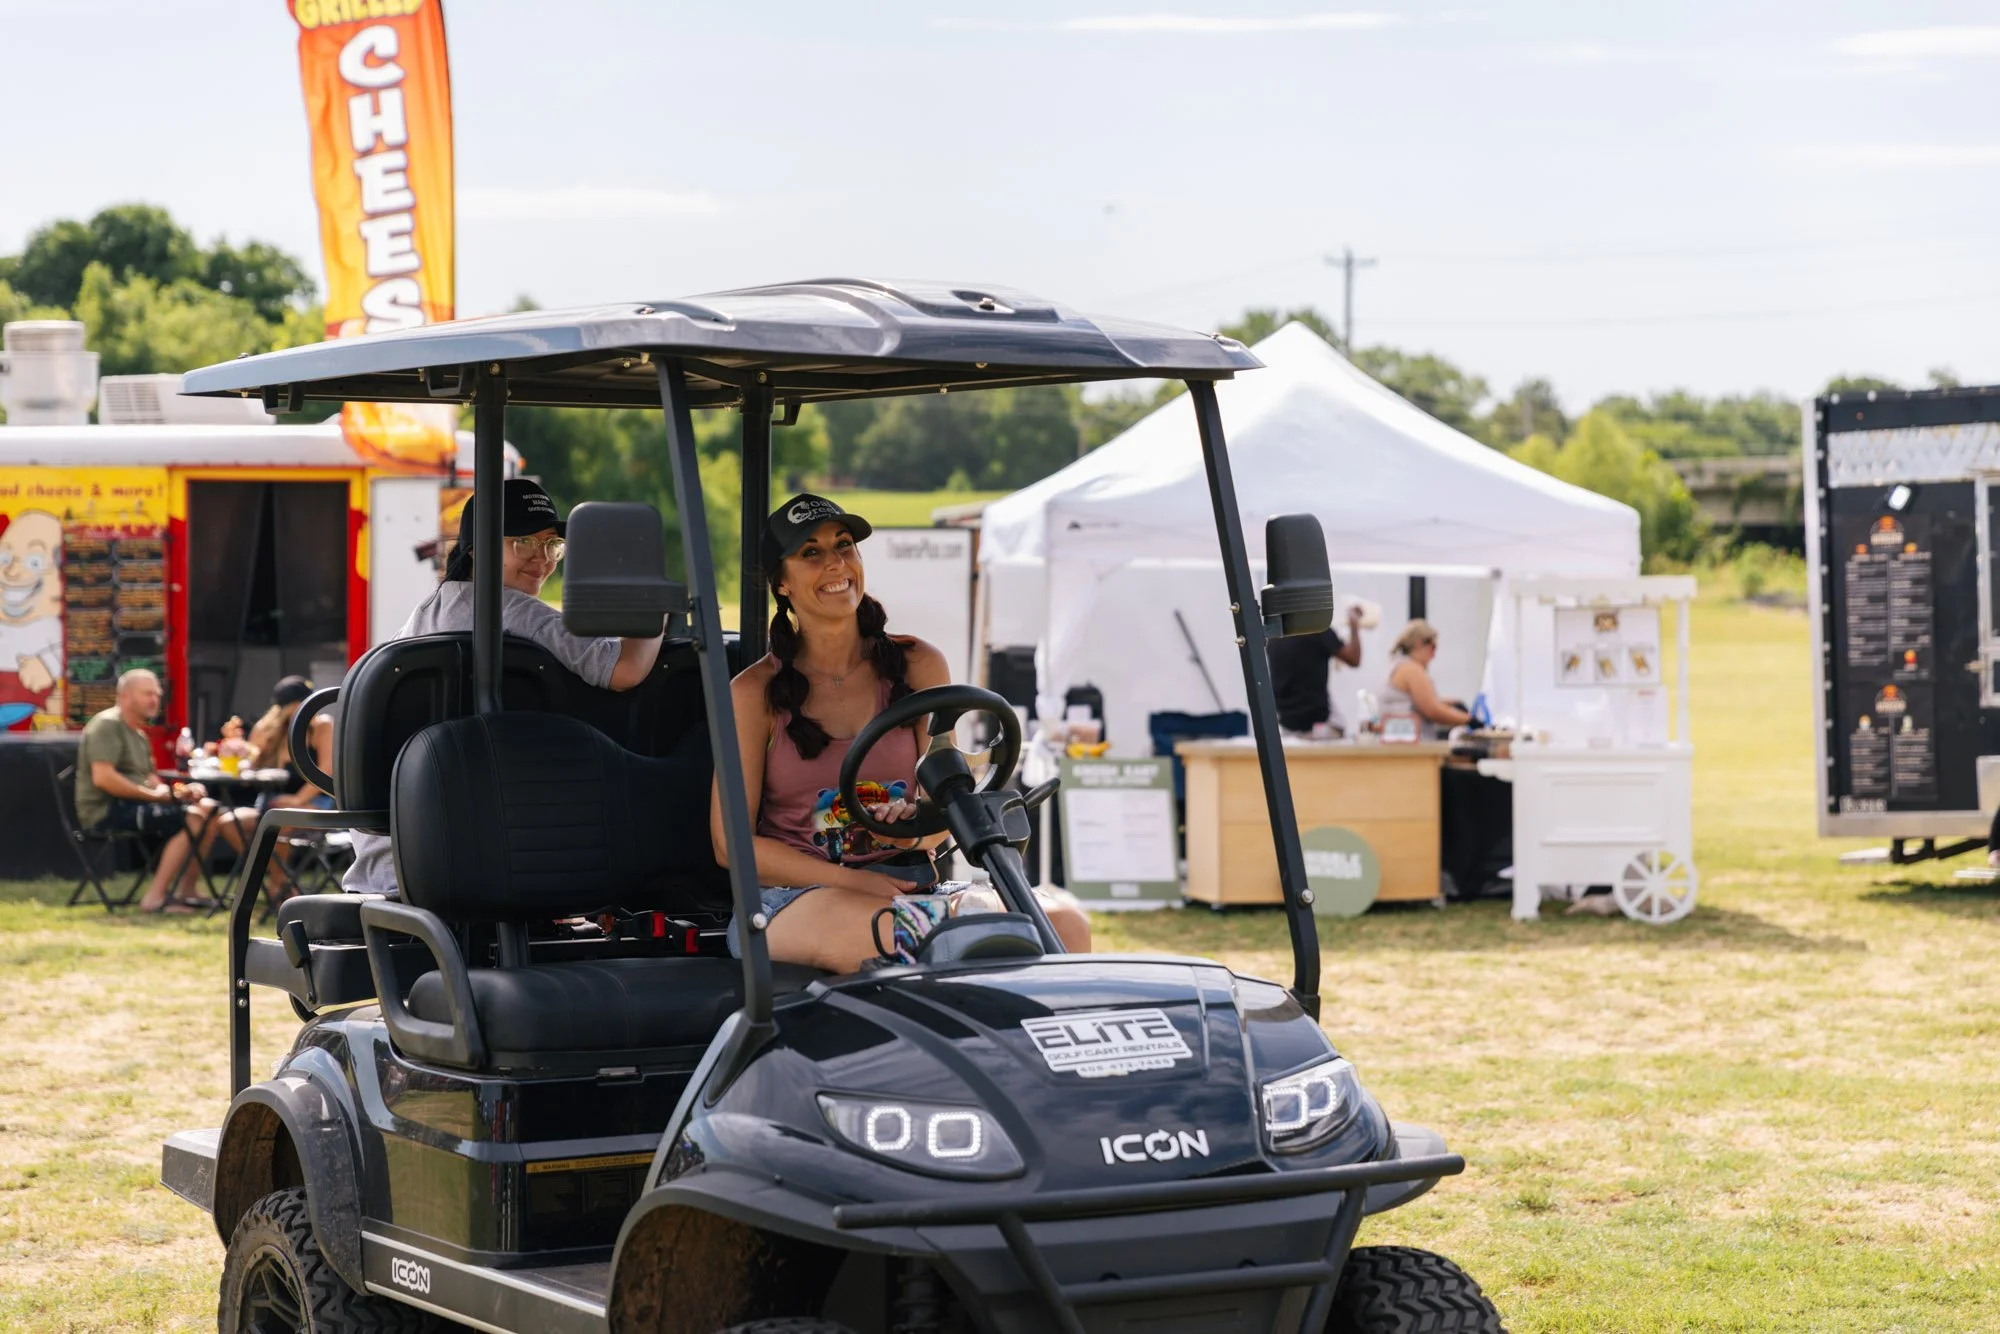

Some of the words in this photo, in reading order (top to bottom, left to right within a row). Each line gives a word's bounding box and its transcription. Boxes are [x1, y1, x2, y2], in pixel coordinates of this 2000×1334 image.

[1030, 1017, 1176, 1049] ELITE
[1049, 1051, 1081, 1061] GOLF
[1083, 1046, 1119, 1057] CART
[1121, 1042, 1182, 1053] RENTALS
[1100, 1129, 1210, 1165] ICON
[393, 1258, 429, 1292] ICON
